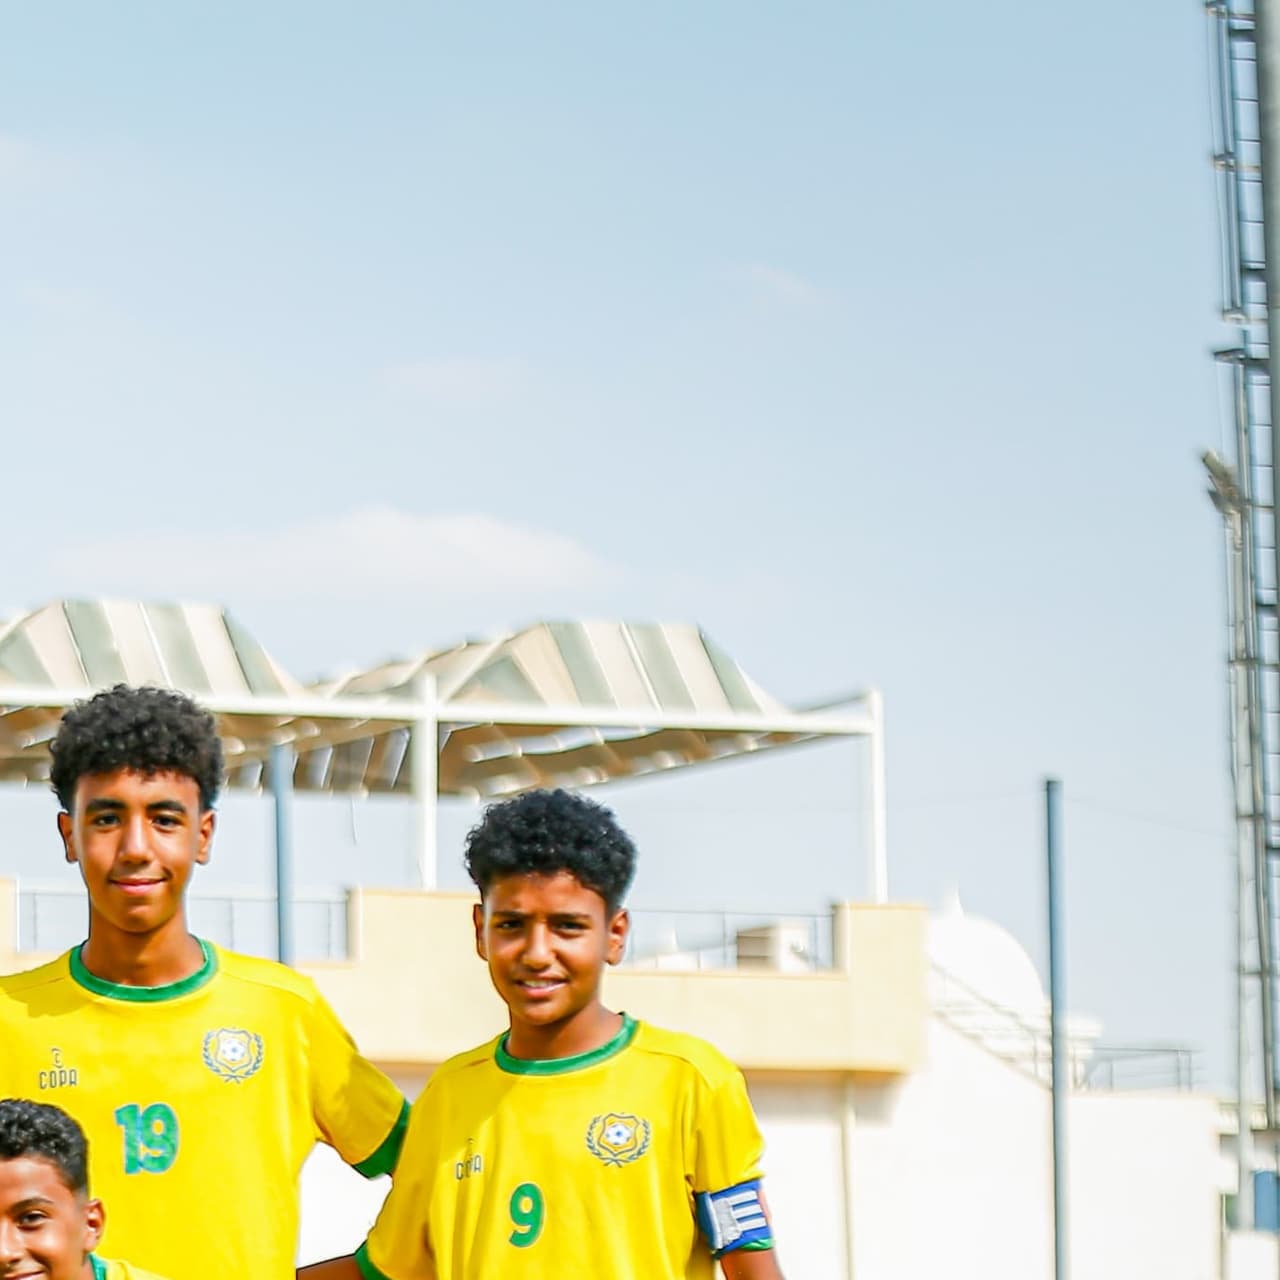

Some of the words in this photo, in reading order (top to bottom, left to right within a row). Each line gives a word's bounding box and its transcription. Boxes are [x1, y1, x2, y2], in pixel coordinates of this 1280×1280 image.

[39, 1069, 77, 1089] COPA
[114, 1103, 178, 1174] 19
[509, 1183, 544, 1248] 9
